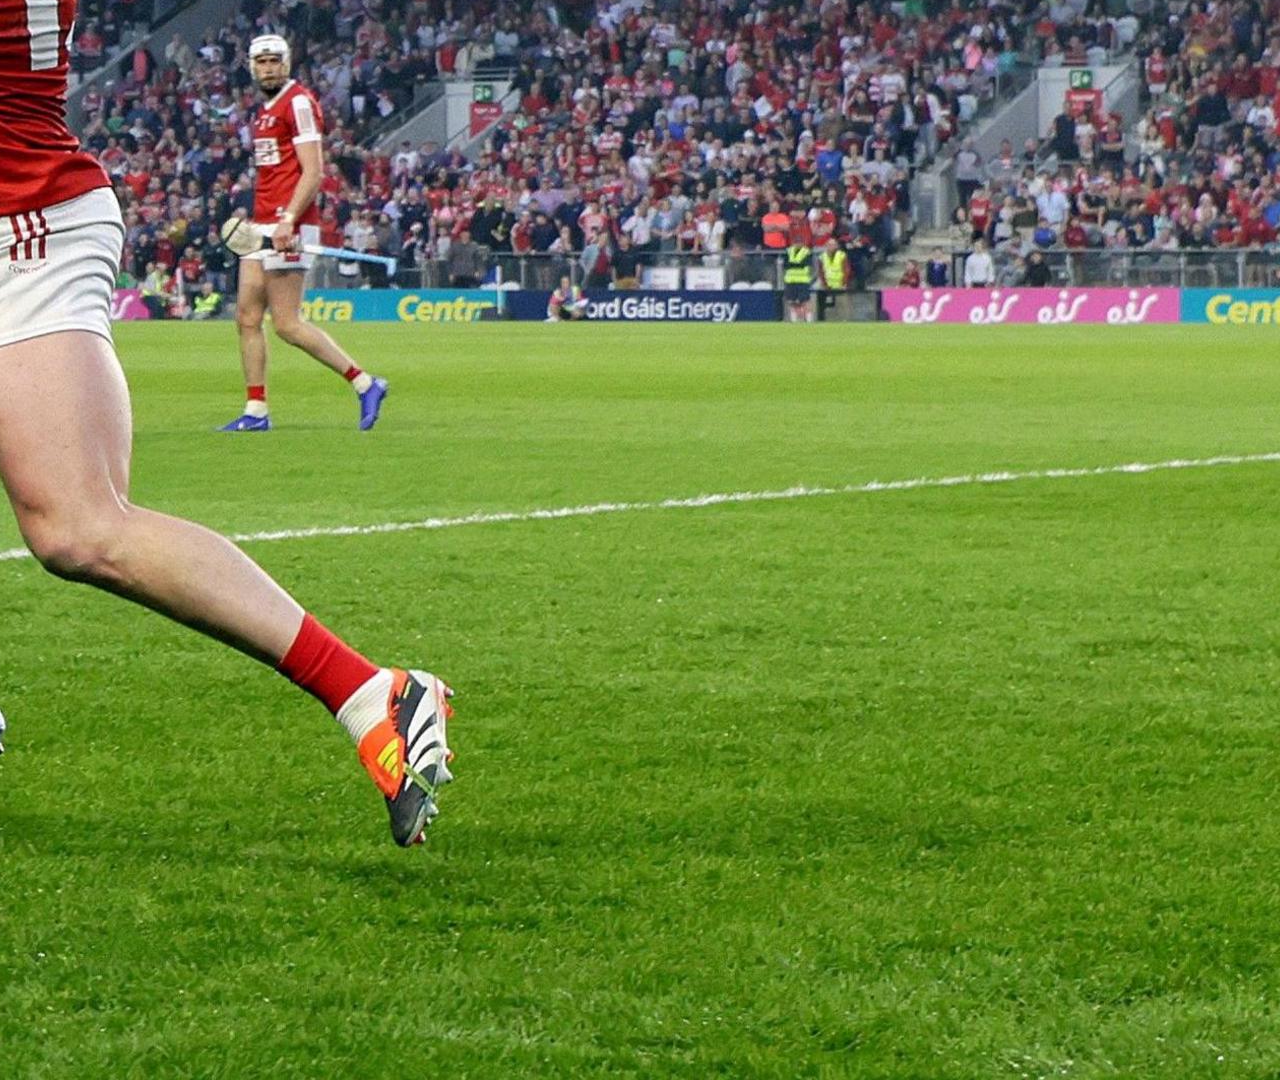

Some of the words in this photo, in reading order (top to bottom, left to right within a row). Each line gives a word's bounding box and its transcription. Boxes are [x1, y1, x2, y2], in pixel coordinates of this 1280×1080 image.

[586, 296, 619, 319] ord
[622, 293, 666, 319] Gáis
[668, 295, 739, 322] Energy
